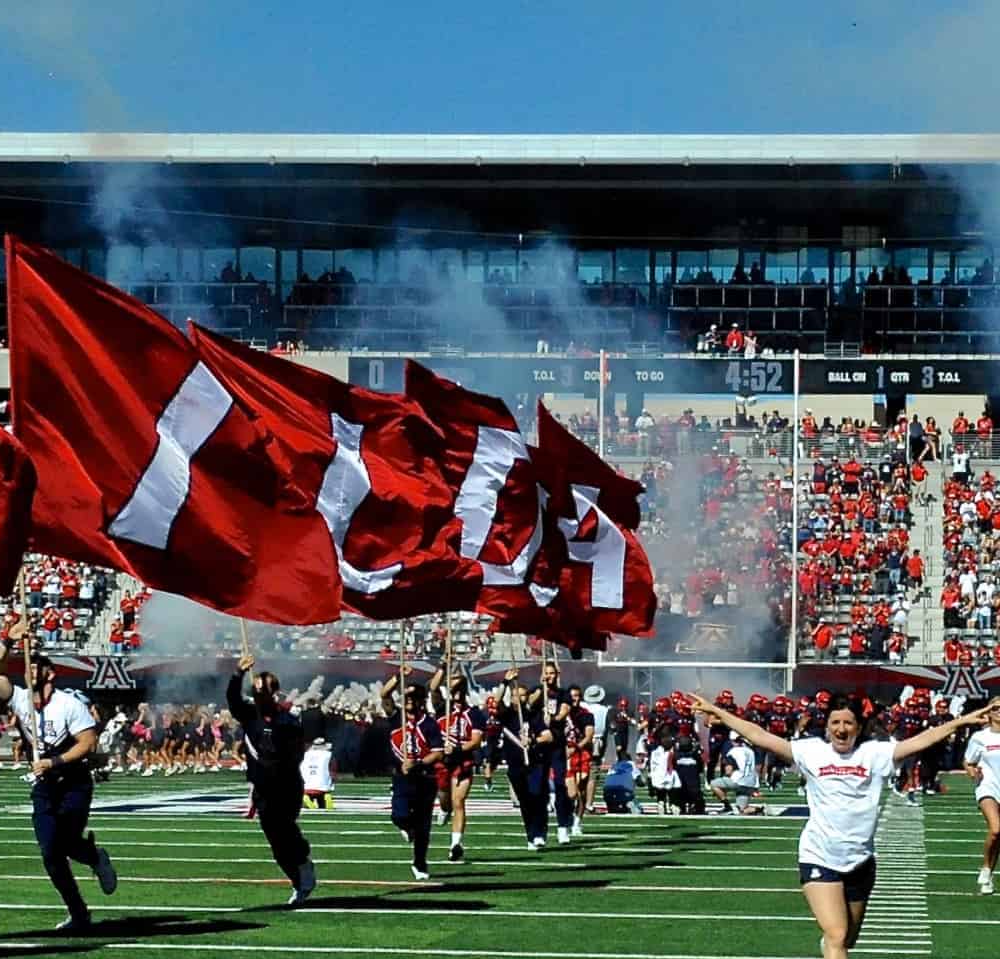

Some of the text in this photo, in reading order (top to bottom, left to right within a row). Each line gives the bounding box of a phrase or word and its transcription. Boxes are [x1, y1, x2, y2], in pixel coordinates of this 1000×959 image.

[369, 360, 384, 389] 0
[635, 371, 664, 381] TO GO
[725, 362, 782, 391] 4:52
[828, 371, 867, 382] BALL ON
[876, 365, 884, 388] 1
[921, 366, 934, 388] 3
